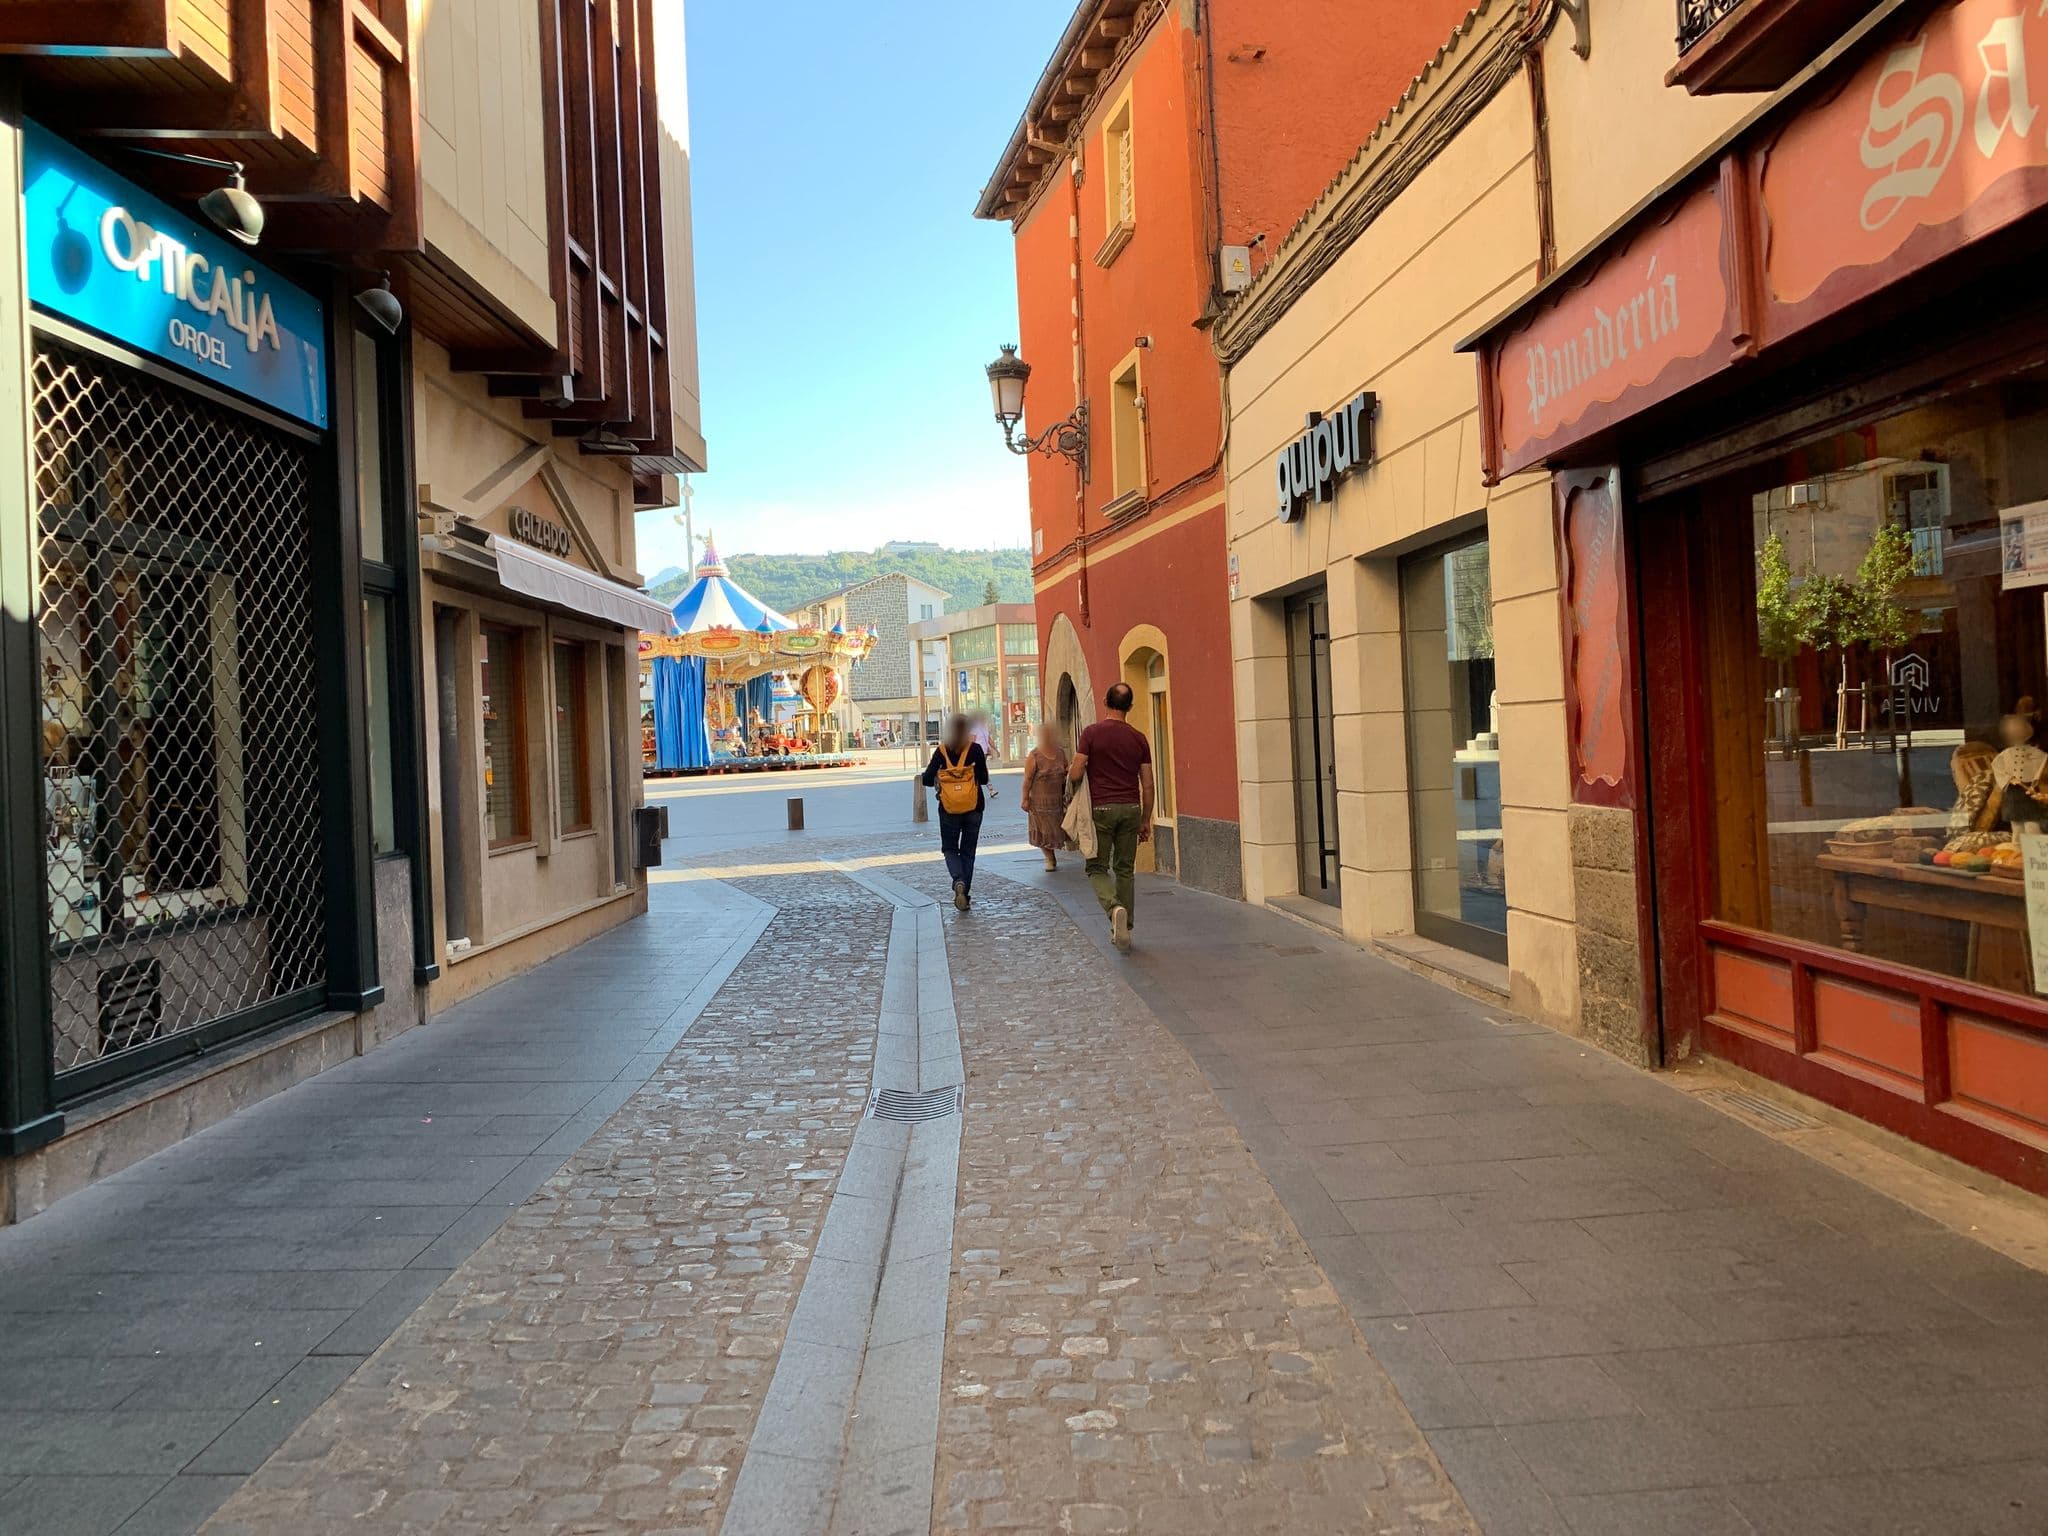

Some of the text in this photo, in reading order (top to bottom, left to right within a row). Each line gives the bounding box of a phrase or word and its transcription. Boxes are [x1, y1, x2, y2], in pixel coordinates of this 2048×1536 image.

[1859, 0, 2048, 232] Sa
[1526, 256, 1680, 425] Panadería
[1276, 391, 1376, 523] guipur
